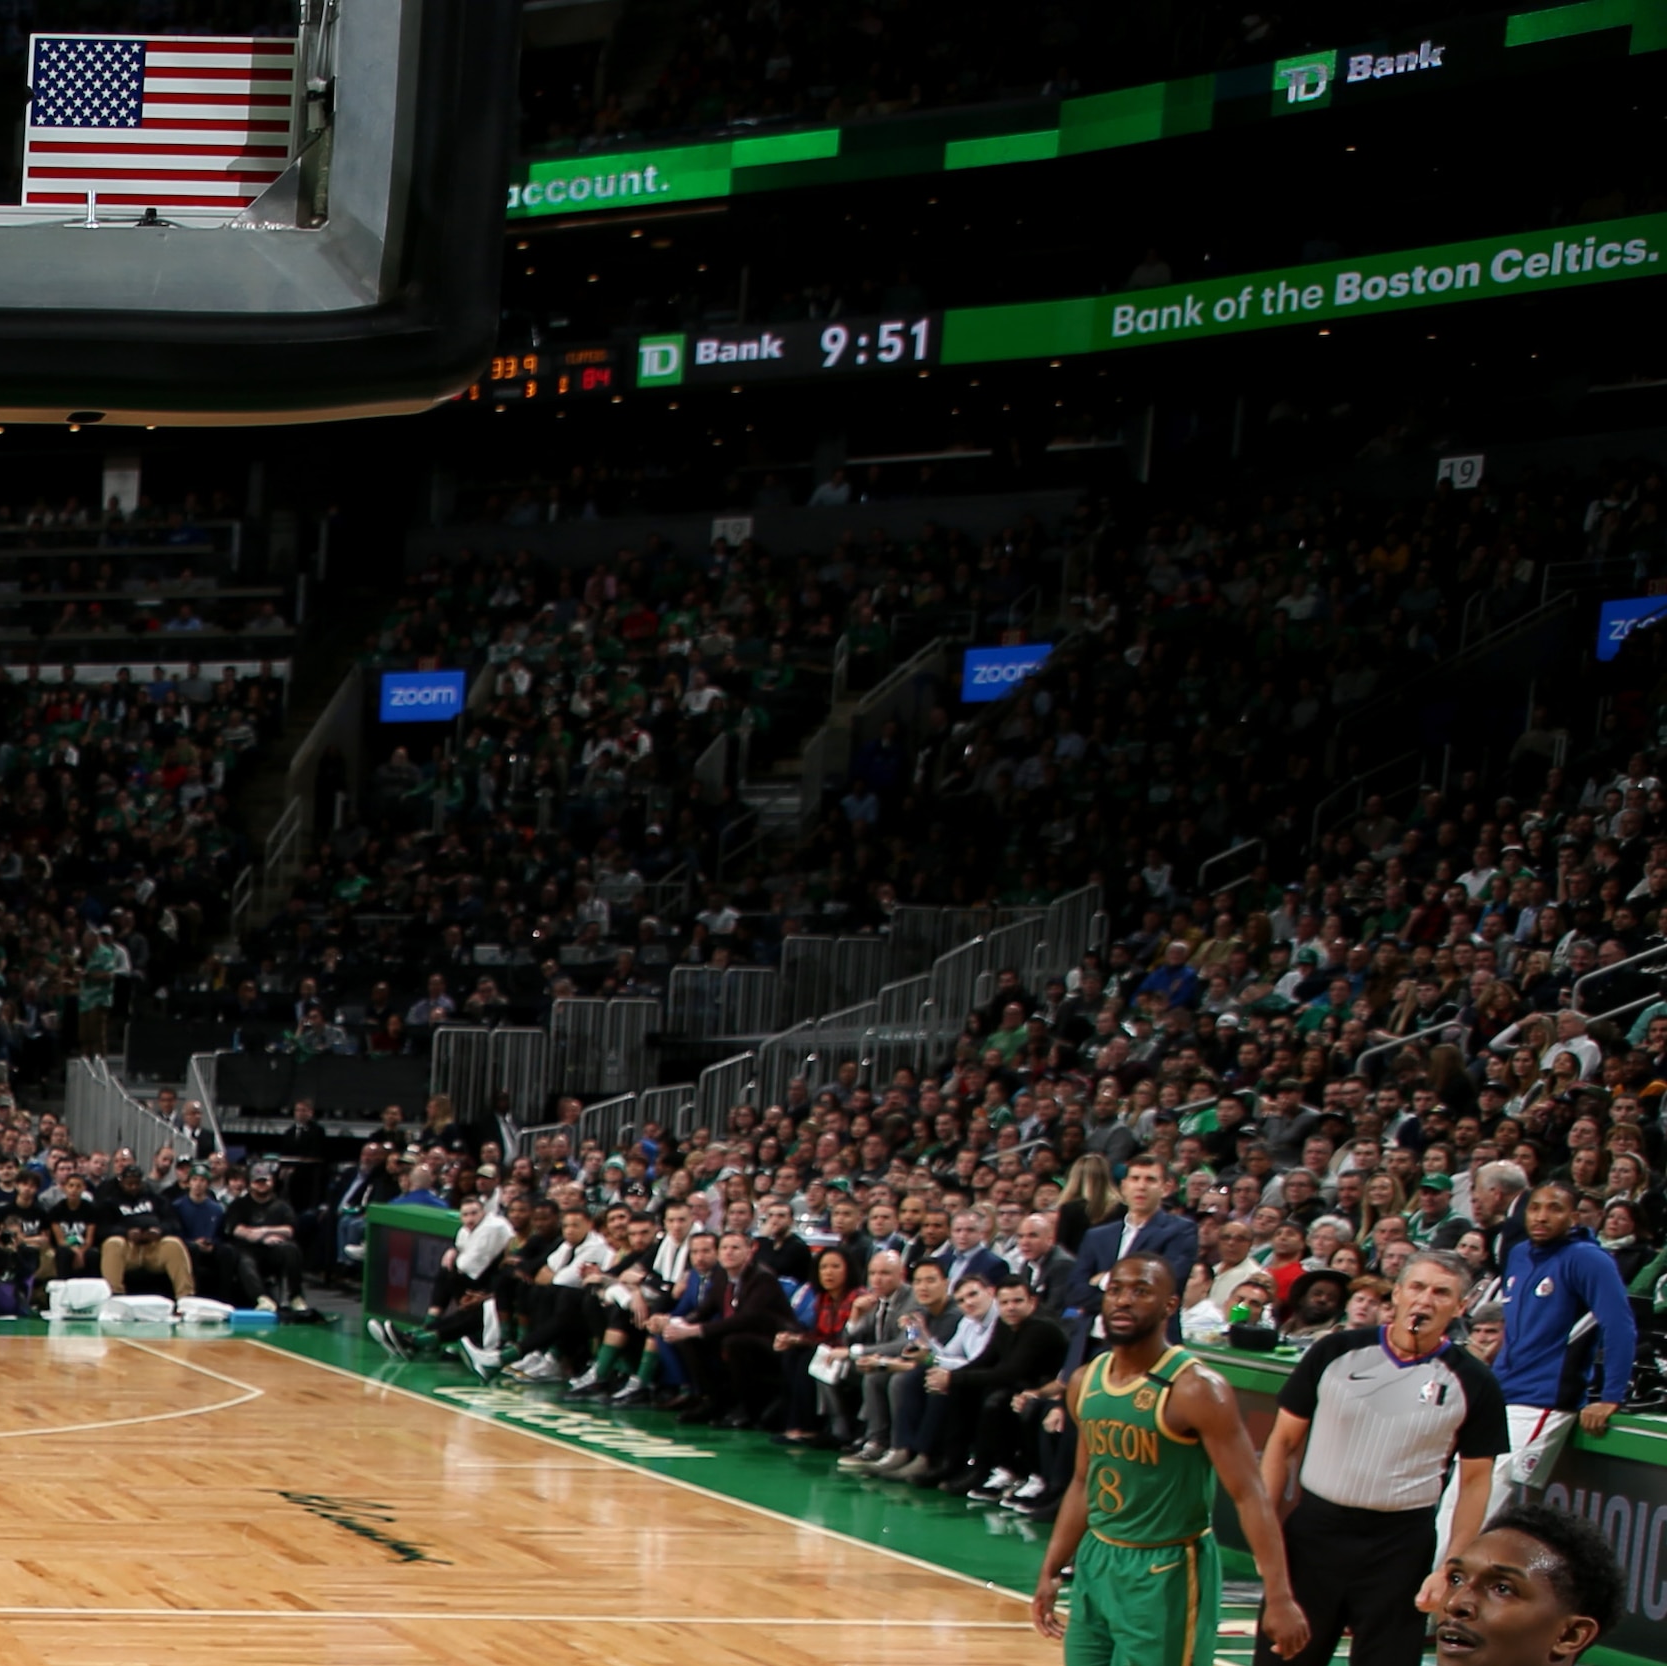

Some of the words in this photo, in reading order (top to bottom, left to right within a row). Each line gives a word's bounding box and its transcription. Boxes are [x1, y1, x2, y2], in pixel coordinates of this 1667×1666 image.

[1346, 41, 1446, 83] Bank
[1110, 294, 1204, 338] Bank
[1213, 285, 1257, 328] of
[1260, 278, 1323, 317] the
[1333, 258, 1481, 306] Boston
[1489, 235, 1660, 285] Celtics.
[639, 343, 680, 376] TD
[694, 333, 784, 367] Bank
[819, 316, 931, 367] 9:51
[389, 684, 457, 707] zoom
[1097, 1466, 1124, 1513] 8
